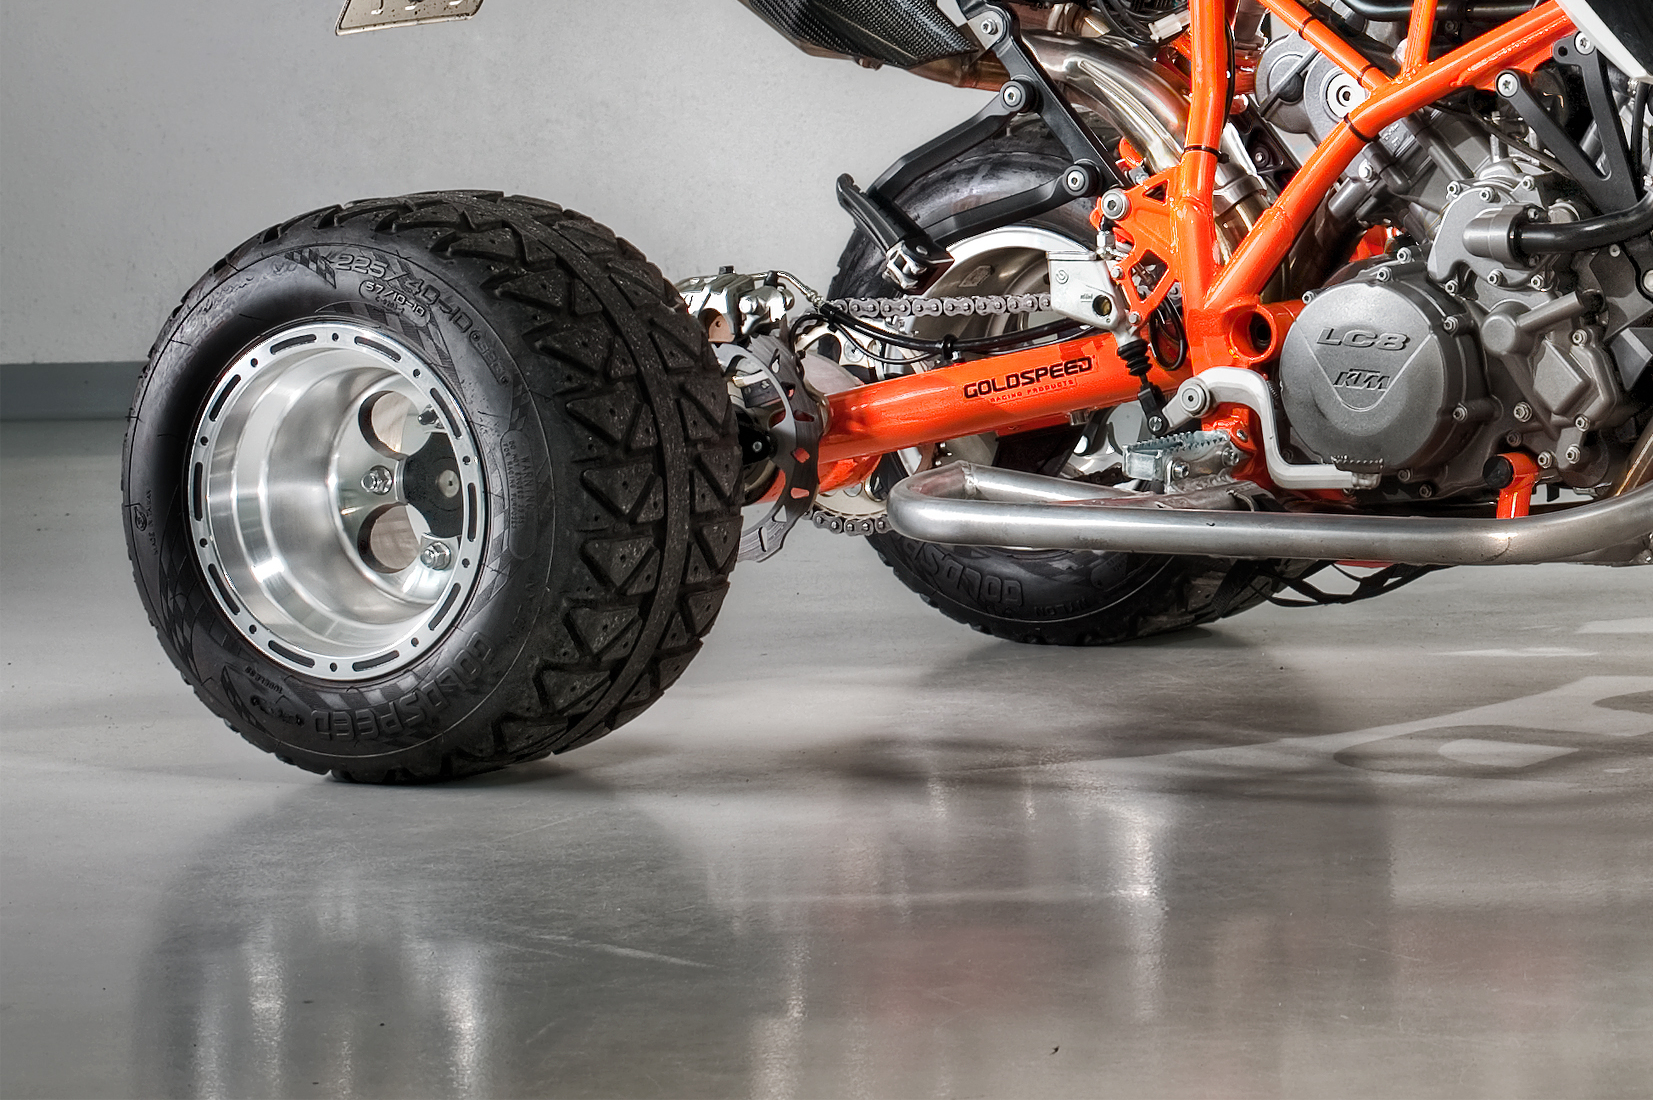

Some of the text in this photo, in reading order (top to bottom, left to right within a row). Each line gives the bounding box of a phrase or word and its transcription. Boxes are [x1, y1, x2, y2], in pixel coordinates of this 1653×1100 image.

[1317, 327, 1410, 351] LC8
[963, 356, 1093, 399] GOLDSPEED
[1333, 368, 1391, 392] KTM
[990, 379, 1074, 403] RACING PRODUCTS
[311, 631, 492, 741] GOLDSPEED
